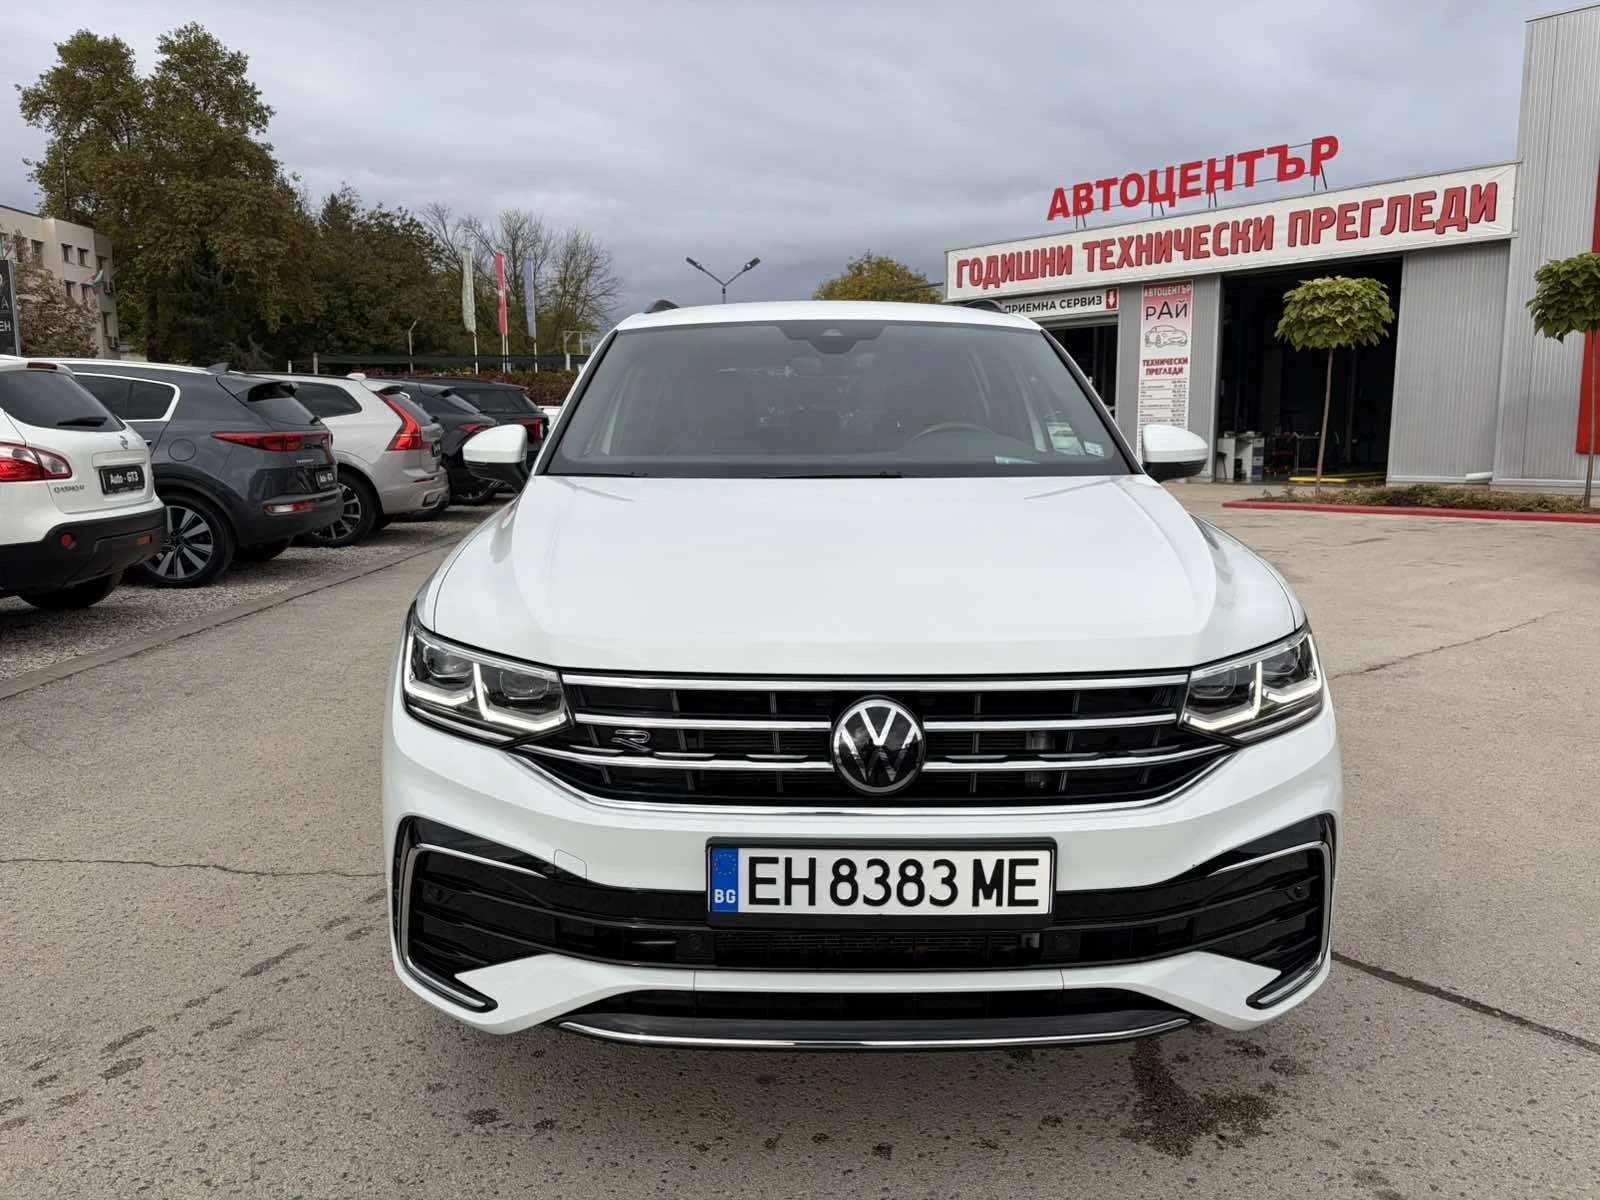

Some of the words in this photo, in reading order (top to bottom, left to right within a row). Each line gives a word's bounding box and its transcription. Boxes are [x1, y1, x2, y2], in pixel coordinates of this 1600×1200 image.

[1047, 135, 1339, 221] АВТОЦЕНТЪР
[956, 244, 1073, 290] ГОДИШНИ
[1083, 214, 1275, 272] ТЕХНИЧЕСКИ
[1287, 181, 1498, 248] ПРЕГЛЕДИ
[1143, 284, 1192, 297] АВТОЦЕНТЪР
[1004, 301, 1057, 314] ПРИЕМНА
[1059, 295, 1103, 309] СЕРВИЗ
[1142, 357, 1188, 367] ТЕХНИЧЕСКИ
[1145, 367, 1184, 376] ПРЕГЛЕДИ
[713, 888, 737, 904] BG
[748, 857, 817, 906] EH
[829, 857, 959, 907] 8383
[971, 858, 1039, 907] ME
